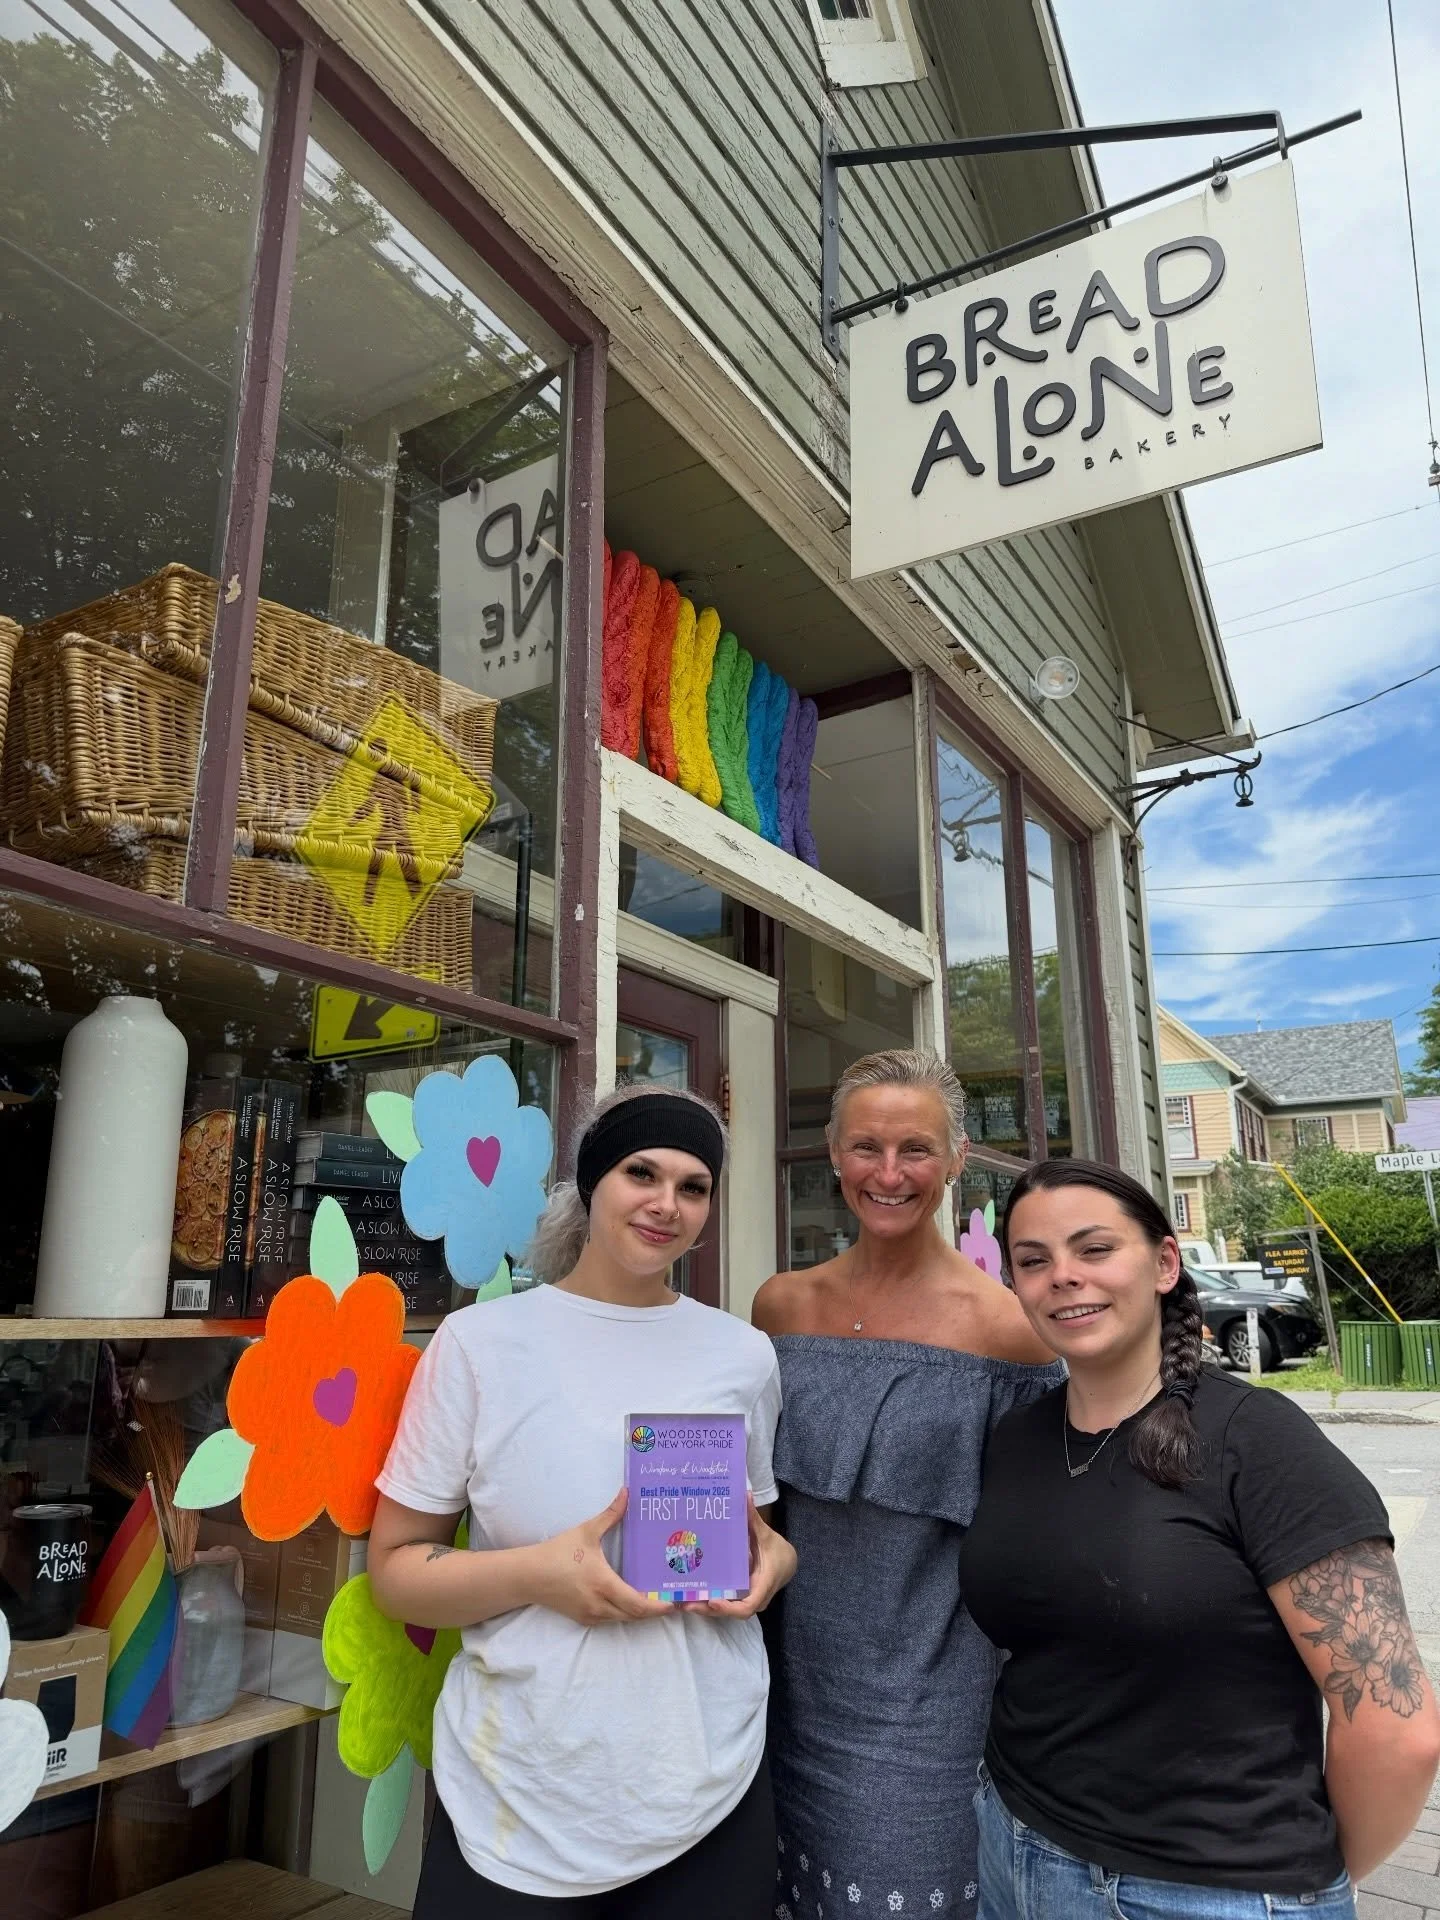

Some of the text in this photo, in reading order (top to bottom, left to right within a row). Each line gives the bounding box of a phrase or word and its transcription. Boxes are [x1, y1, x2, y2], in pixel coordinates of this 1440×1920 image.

[906, 235, 1226, 403] BREAD
[911, 320, 1234, 496] ALONE
[1084, 413, 1232, 470] BAKERY
[1381, 1153, 1424, 1169] Maple
[225, 1156, 248, 1262] A SLOW RISE
[362, 1196, 372, 1207] A
[256, 1158, 278, 1263] A SLOW RISE
[356, 1220, 366, 1233] A
[368, 1221, 400, 1235] SLOW
[364, 1246, 396, 1260] SLOW
[398, 1247, 422, 1264] RISE
[1265, 1248, 1309, 1258] FLEA MARKET
[1273, 1258, 1305, 1266] SATURDAY
[1285, 1267, 1310, 1275] SUNDAY
[396, 1271, 419, 1289] RISE
[657, 1429, 733, 1439] WOODSTOCK
[657, 1439, 734, 1449] NEW YORK PRIDE
[640, 1459, 730, 1476] Windows of Woodstock
[640, 1486, 731, 1497] Best Pride Window 2025
[640, 1496, 731, 1521] FIRST PLACE
[38, 1540, 88, 1561] BREAD
[36, 1556, 87, 1582] ALONE
